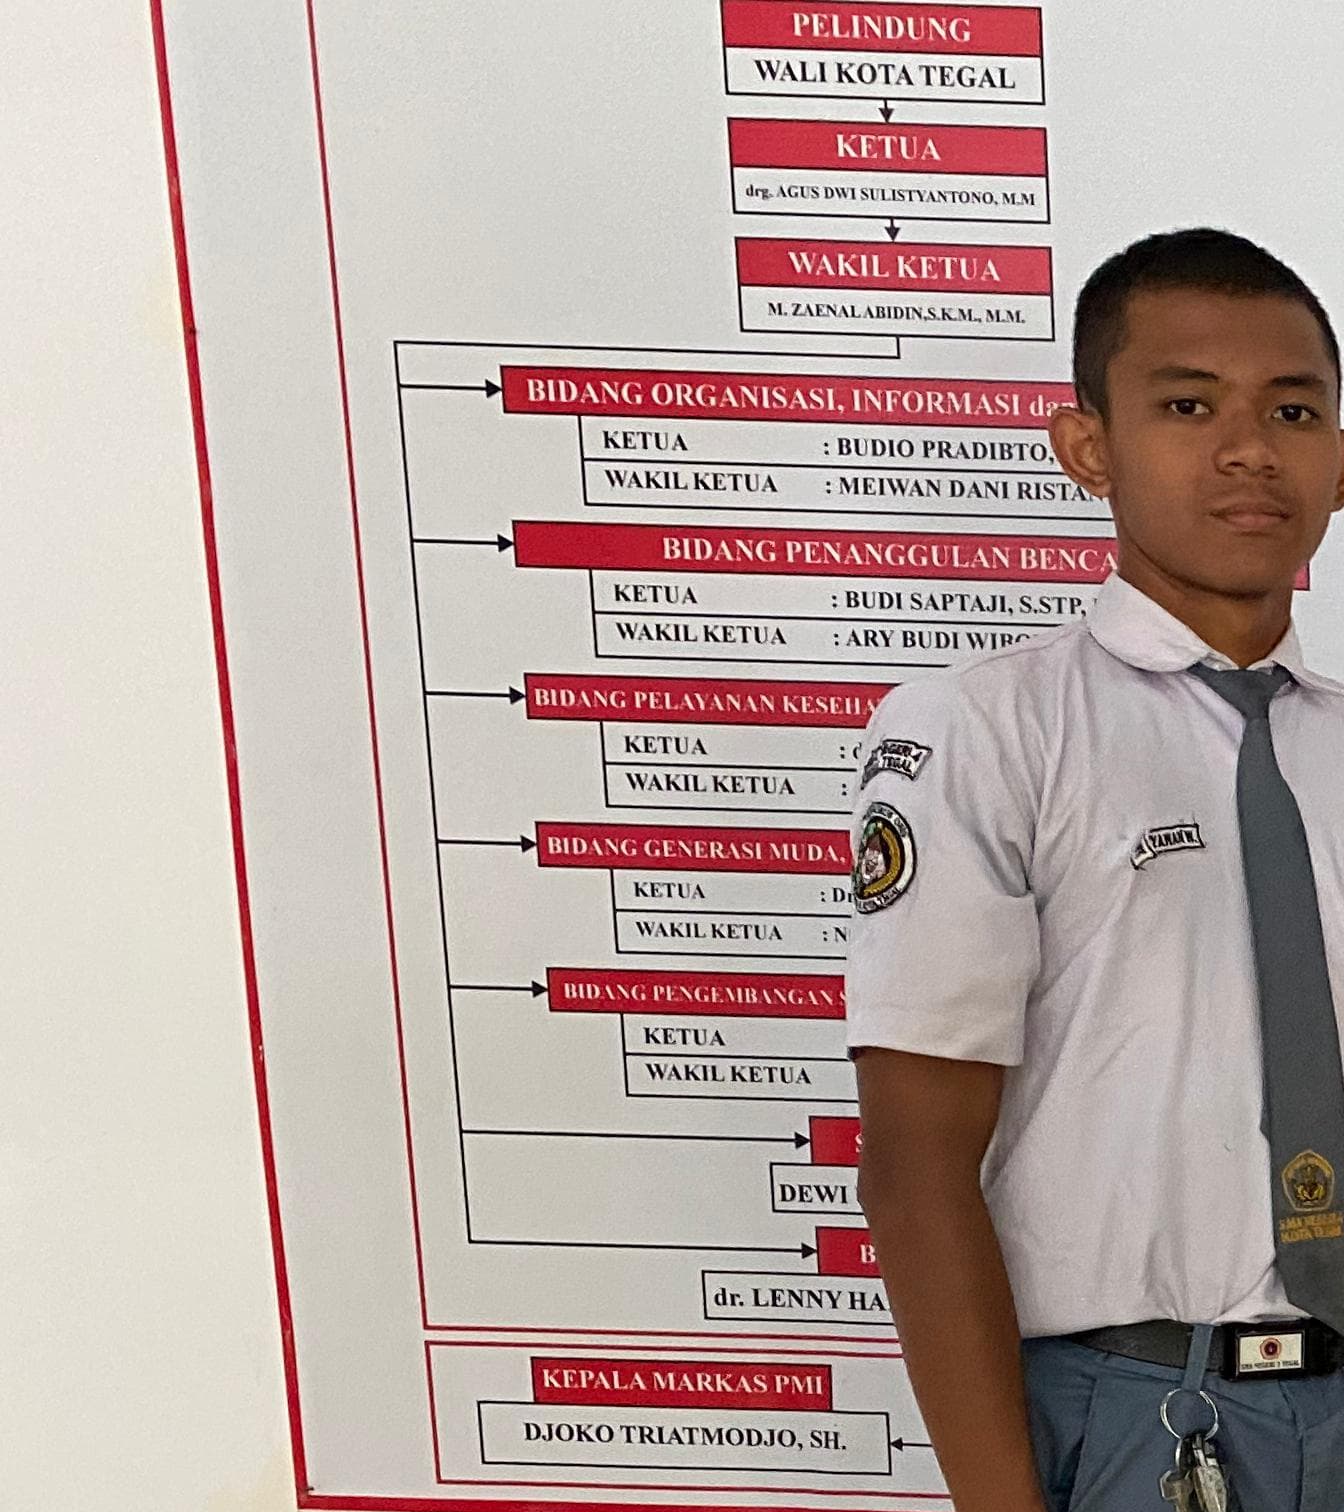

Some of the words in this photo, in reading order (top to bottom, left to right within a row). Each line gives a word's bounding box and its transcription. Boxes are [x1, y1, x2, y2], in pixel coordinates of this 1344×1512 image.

[794, 13, 970, 41] PELINDUNG
[755, 60, 826, 82] WALI
[836, 63, 914, 85] KOTA
[919, 65, 1015, 88] TEGAL
[837, 135, 940, 160] KETUA
[746, 184, 773, 200] drg.
[777, 186, 819, 198] AGUS
[824, 187, 856, 200] DWI
[861, 188, 998, 205] SULISTYANTONO,
[789, 252, 889, 277] WAKIL
[898, 256, 1000, 281] KETUA
[768, 303, 787, 315] M.
[792, 303, 861, 318] ZAENAL
[528, 380, 642, 404] BIDANG
[652, 384, 844, 413] ORGANISASI,
[853, 390, 1019, 415] INFORMASI
[603, 431, 688, 451] KETUA
[838, 438, 914, 457] BUDIO
[922, 441, 1054, 465] PRADIBTO,
[605, 470, 688, 490] WAKIL
[694, 473, 777, 492] KETUA
[840, 477, 940, 497] MEIWAN
[950, 480, 1008, 499] DANI
[1017, 482, 1096, 501] RISTA
[664, 538, 776, 561] BIDANG
[787, 541, 1009, 568] PENANGGULAN
[1020, 547, 1118, 572] BENCA
[615, 584, 697, 604] KETUA
[846, 591, 902, 609] BUDI
[911, 593, 1013, 615] SAPTAJI,
[1020, 596, 1086, 617] S.STP,
[616, 623, 697, 642] WAKIL
[704, 625, 786, 644] KETUA
[847, 630, 894, 647] ARY
[903, 631, 959, 649] BUDI
[535, 689, 625, 707] BIDANG
[635, 692, 774, 712] PELAYANAN
[783, 695, 881, 716] KESEHA
[625, 736, 707, 755] KETUA
[626, 773, 706, 792] WAKIL
[712, 776, 795, 794] KETUA
[548, 837, 636, 855] BIDANG
[644, 840, 761, 859] GENERASI
[770, 843, 845, 863] MUDA,
[634, 882, 705, 898] KETUA
[636, 922, 706, 938] WAKIL
[712, 924, 782, 940] KETUA
[565, 983, 646, 1000] BIDANG
[654, 986, 832, 1005] PENGEMBANGAN
[644, 1028, 725, 1046] KETUA
[646, 1064, 725, 1082] WAKIL
[731, 1066, 811, 1084] KETUA
[780, 1184, 847, 1204] DEWI
[714, 1288, 744, 1306] dr.
[753, 1289, 841, 1309] LENNY
[543, 1369, 646, 1389] KEPALA
[654, 1372, 767, 1392] MARKAS
[775, 1375, 822, 1394] PMI
[525, 1423, 614, 1442] DJOKO
[620, 1425, 803, 1450] TRIATMODJO,
[810, 1430, 846, 1450] SH.
